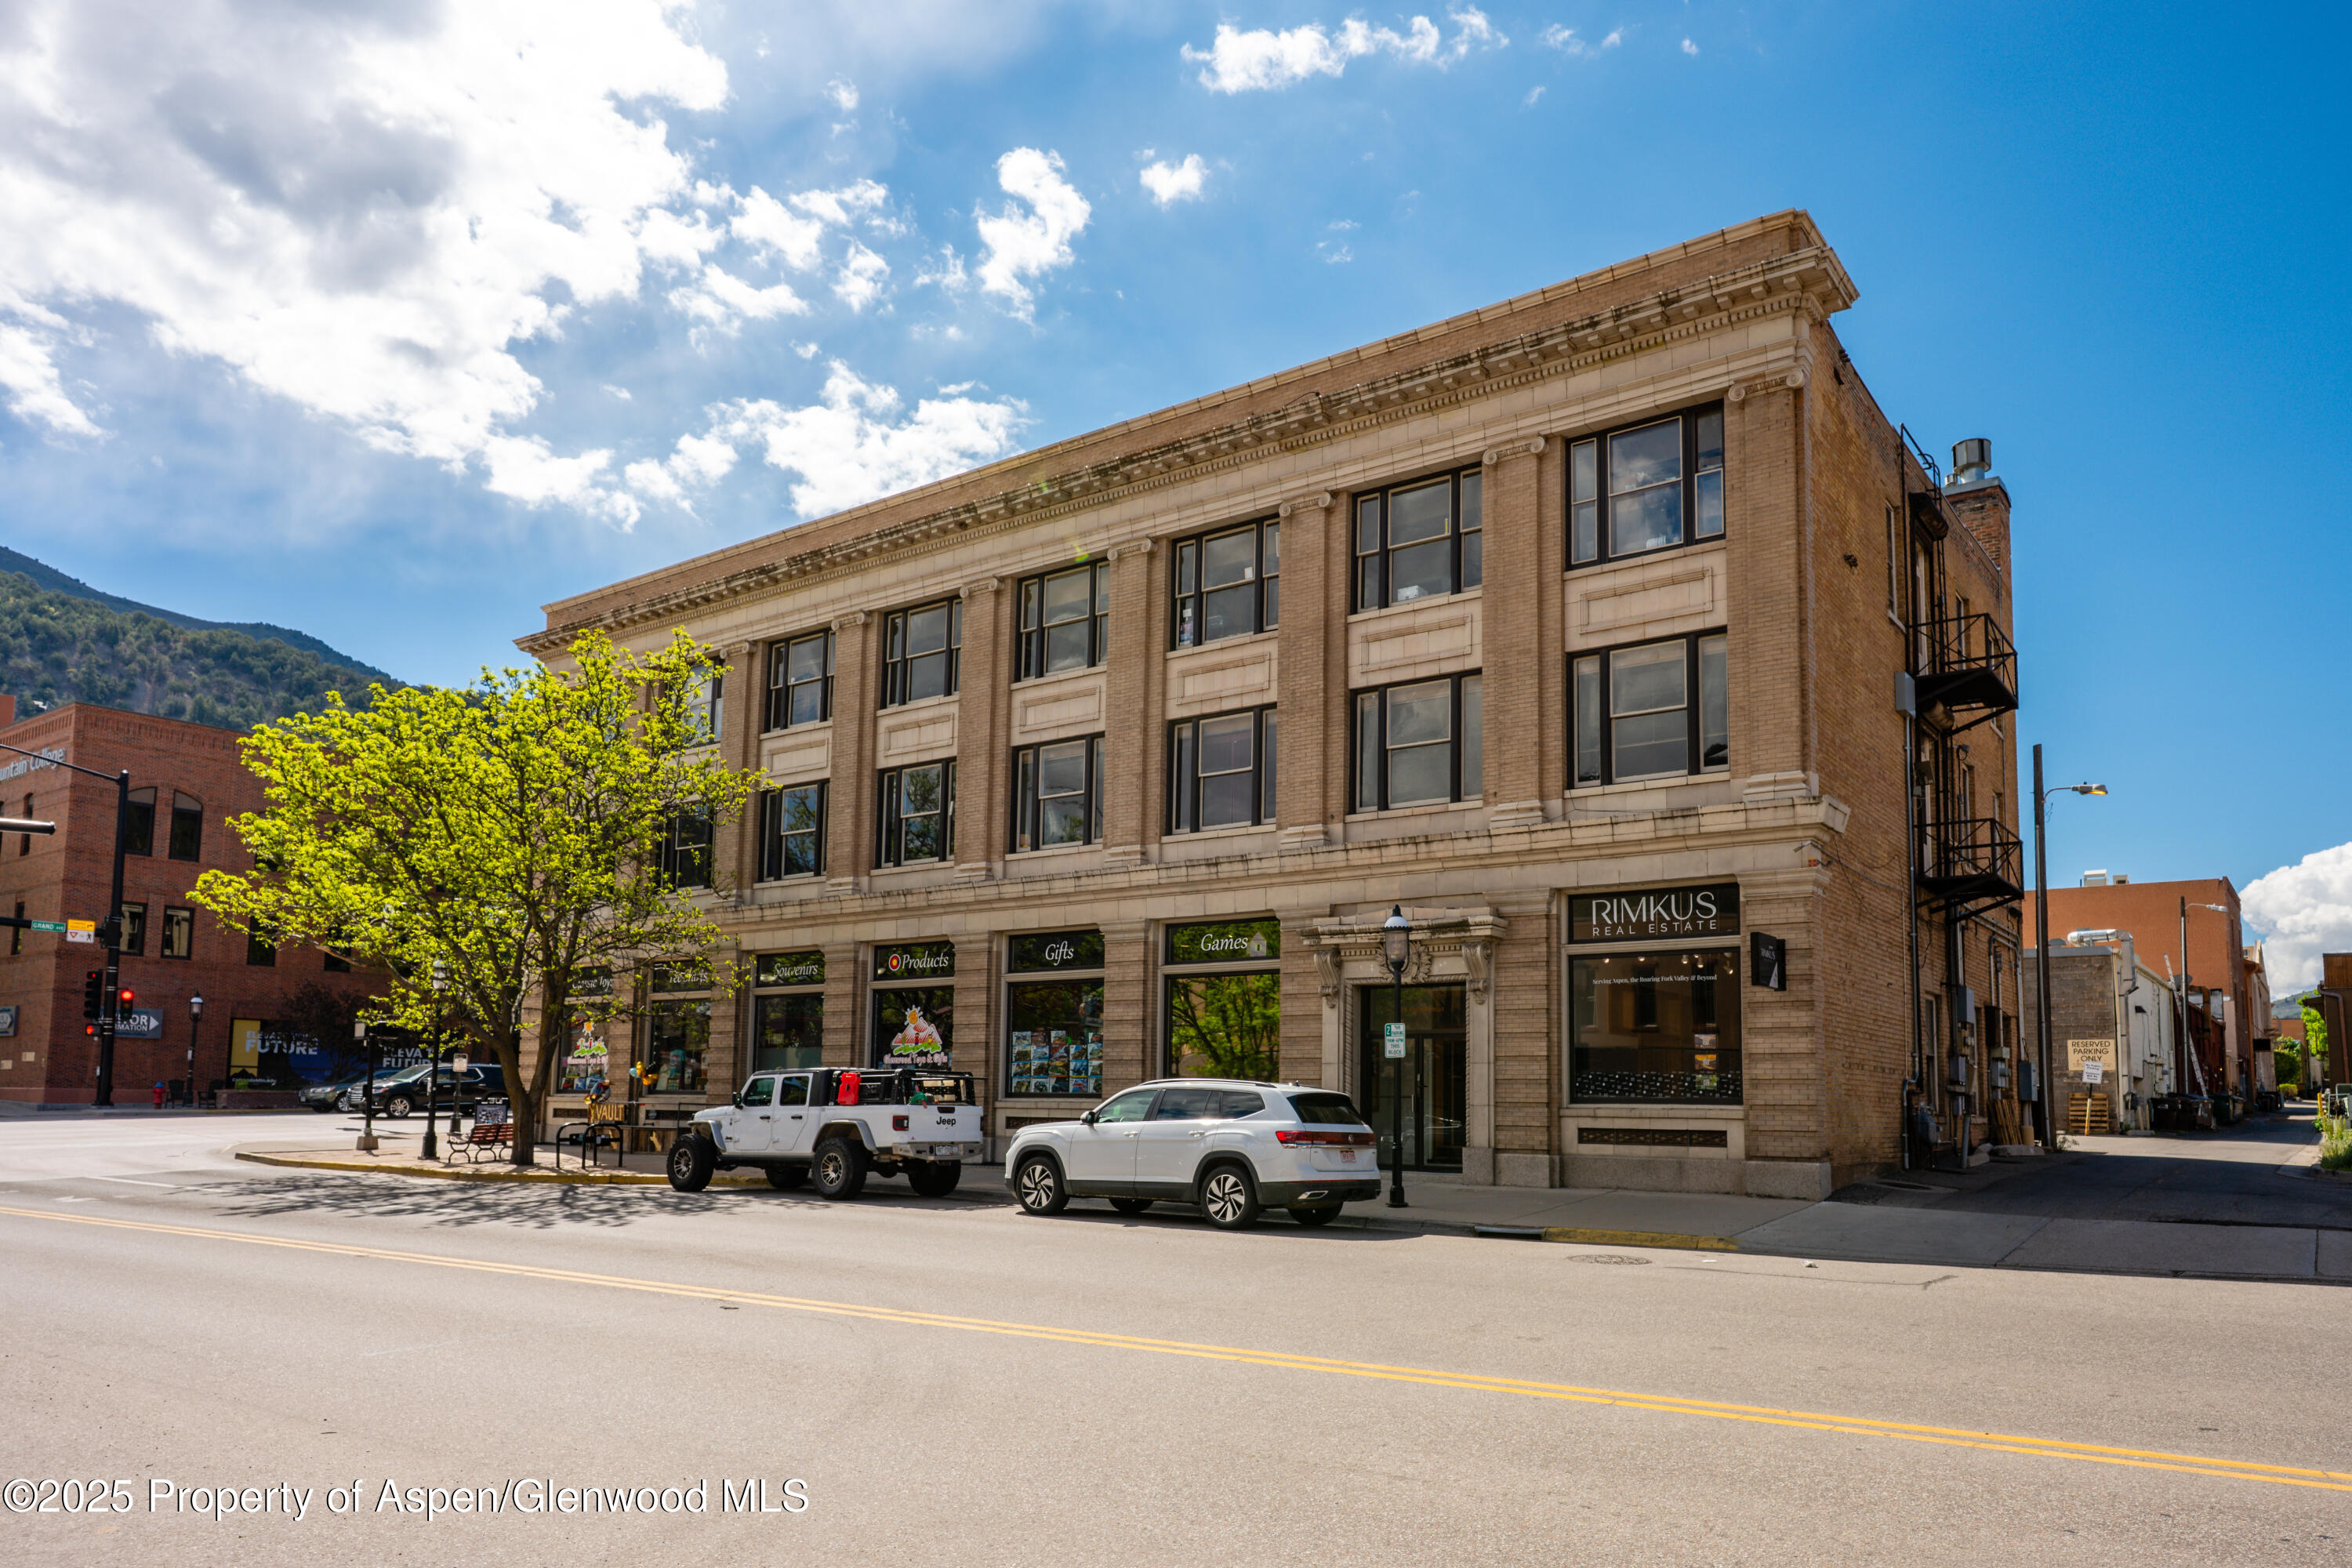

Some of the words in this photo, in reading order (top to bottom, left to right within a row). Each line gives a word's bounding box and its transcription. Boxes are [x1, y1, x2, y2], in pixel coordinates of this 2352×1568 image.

[1592, 891, 1717, 925] RIMKUS
[1592, 925, 1636, 938] REAL
[1648, 920, 1717, 934] ESTATE
[1200, 934, 1249, 952] Games
[902, 950, 949, 970] Products
[1045, 940, 1074, 966] Gifts
[775, 961, 818, 978] Souvenirs
[1387, 1025, 1391, 1035] 2
[245, 1038, 319, 1054] FUTURE
[595, 1104, 625, 1122] VAULT
[936, 1116, 956, 1127] Jeep
